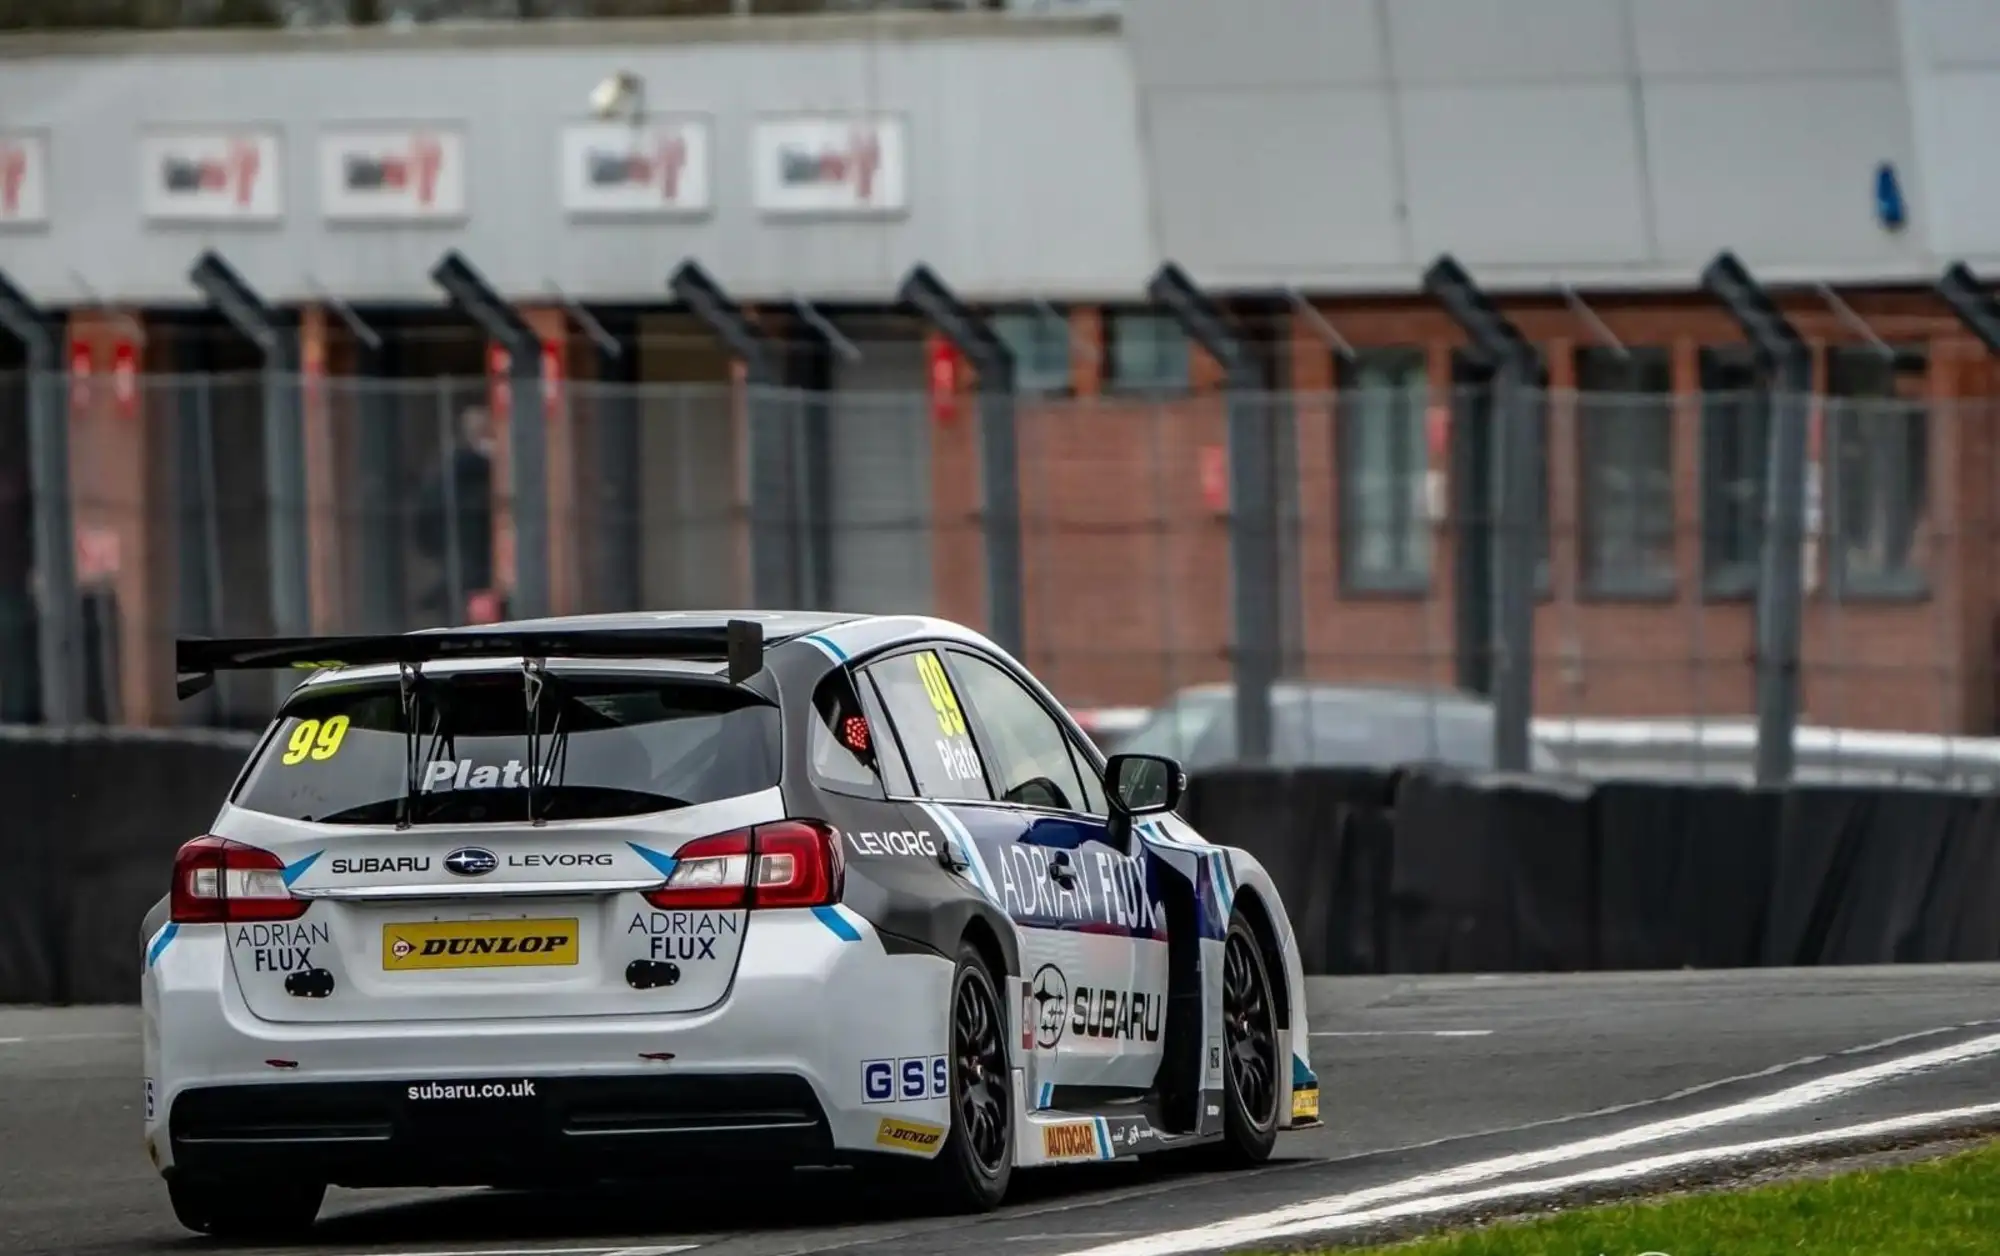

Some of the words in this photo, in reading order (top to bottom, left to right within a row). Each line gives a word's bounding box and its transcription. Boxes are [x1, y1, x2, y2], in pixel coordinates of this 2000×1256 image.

[915, 651, 966, 737] 99
[282, 715, 350, 765] 99
[935, 739, 982, 780] Plato
[421, 759, 551, 795] Plato
[847, 831, 937, 856] LEVORG
[332, 857, 430, 873] SUBARU
[508, 854, 613, 867] LEVORG
[999, 845, 1093, 920] ADRIAN
[1096, 851, 1157, 929] FLUX
[236, 922, 329, 948] ADRIAN
[628, 912, 737, 934] ADRIAN
[420, 937, 568, 956] DUNLOP
[651, 937, 716, 960] FLUX
[255, 947, 314, 972] FLUX
[1071, 986, 1161, 1042] SUBARU
[408, 1079, 536, 1099] subaru.co.uk
[865, 1058, 947, 1099] GSS
[892, 1128, 940, 1144] DUNLOP
[1046, 1126, 1094, 1155] AUTOCAR
